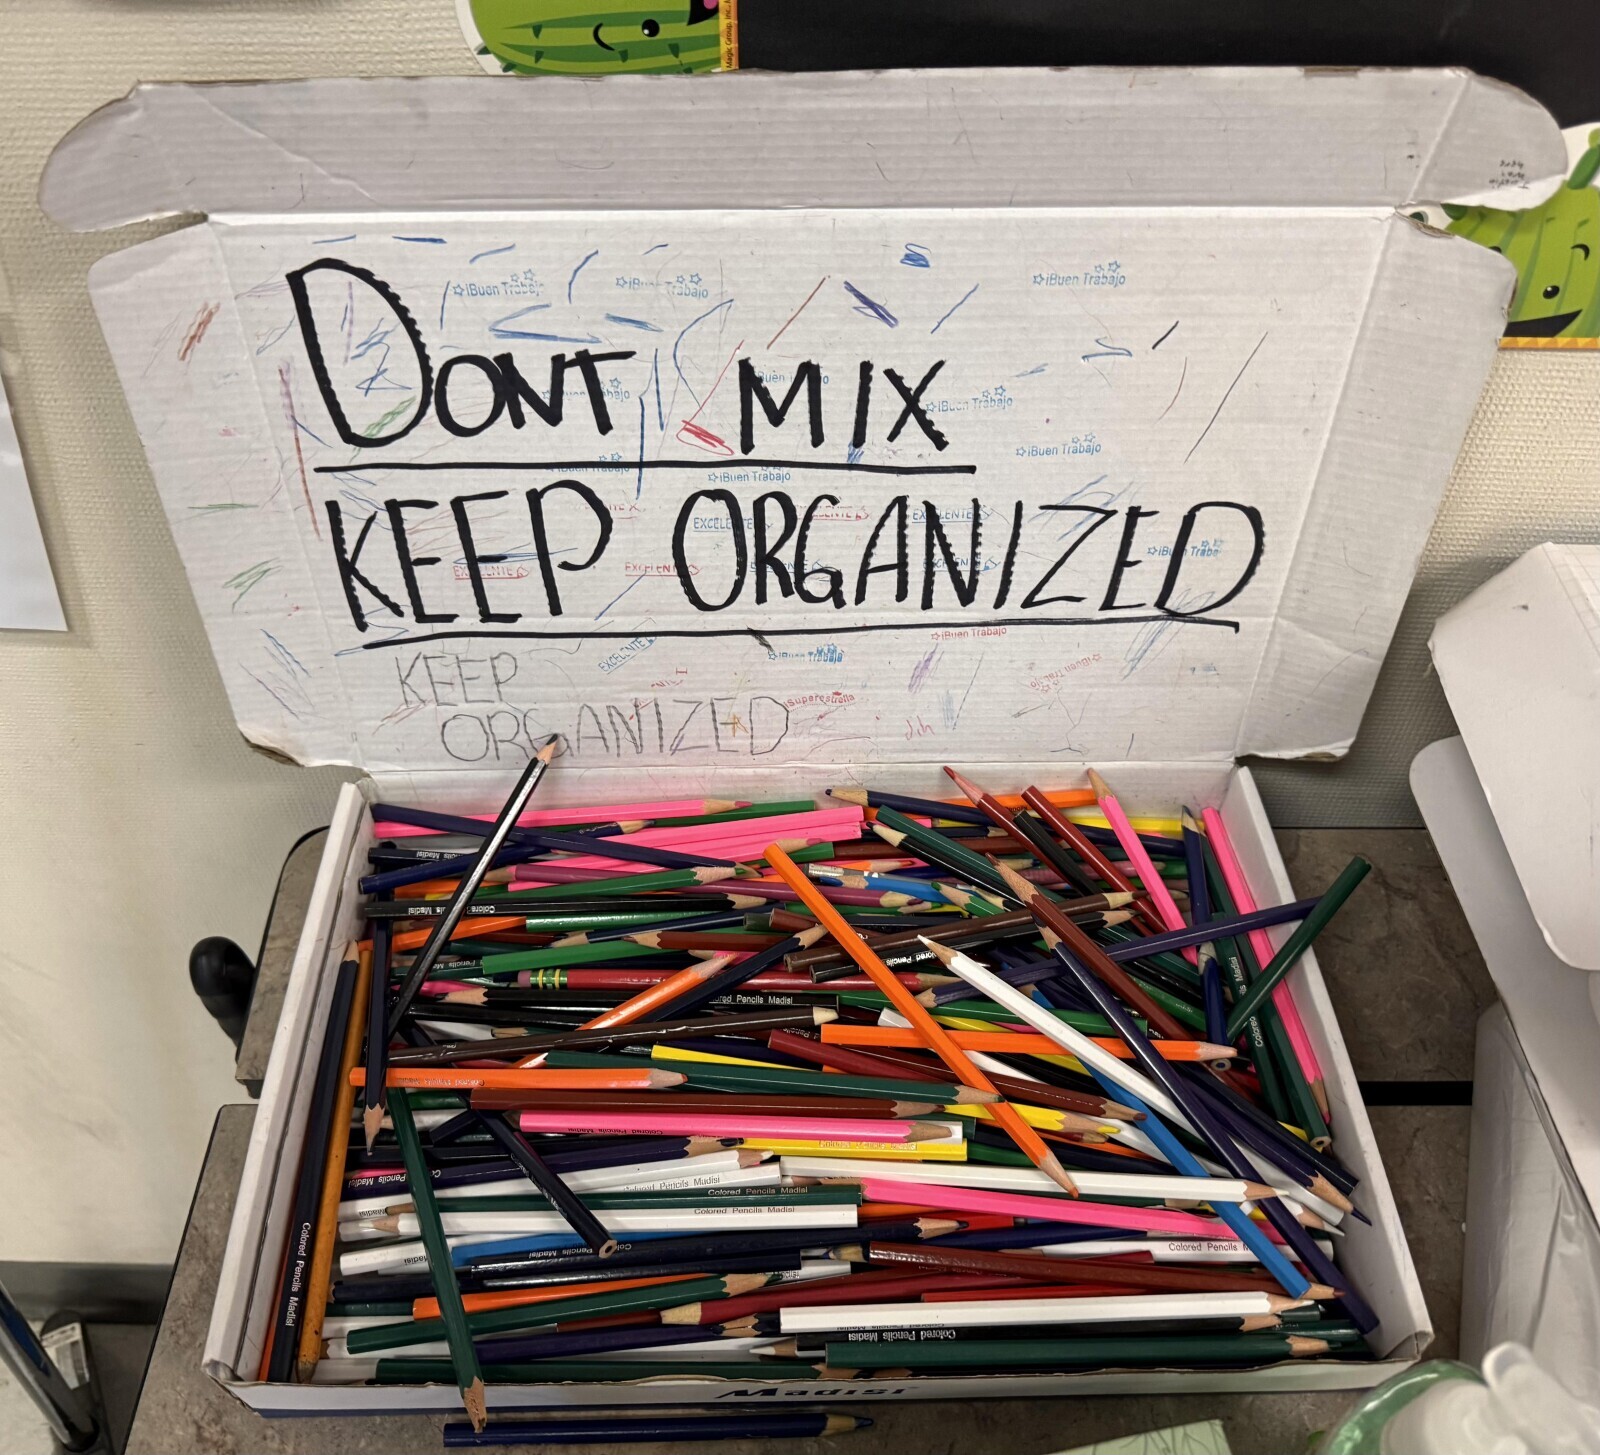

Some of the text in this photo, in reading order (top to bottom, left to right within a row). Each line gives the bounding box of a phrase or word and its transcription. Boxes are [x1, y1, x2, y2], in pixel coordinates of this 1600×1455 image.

[1082, 271, 1127, 288] Trabajo
[739, 356, 949, 455] MIX
[971, 395, 1013, 410] Trabajo
[1061, 442, 1102, 456] Trabajo
[752, 470, 791, 483] Trabajo
[912, 507, 974, 521] EXLENTE
[326, 480, 1264, 631] KEEP ORGANIZED
[971, 626, 1008, 639] Trabajo
[395, 651, 519, 706] KEEP
[1029, 667, 1065, 689] Trabjo
[441, 697, 790, 762] ORGANIZED
[736, 994, 764, 1004] Pencils
[768, 995, 794, 1005] Madisi
[378, 1173, 407, 1184] Pencils
[659, 1178, 689, 1191] Pencils
[707, 1188, 741, 1197] Colored
[746, 1187, 776, 1195] Pencils
[693, 1207, 728, 1215] Colored
[732, 1206, 763, 1214] Pencils
[298, 1222, 312, 1257] Colored
[1168, 1241, 1202, 1252] Colored
[1206, 1242, 1238, 1252] Pencils
[404, 1255, 428, 1266] adisi
[291, 1260, 305, 1293] Pencils
[882, 1330, 916, 1342] Pencils
[920, 1329, 956, 1341] Colored
[714, 1387, 906, 1399] Madisi
